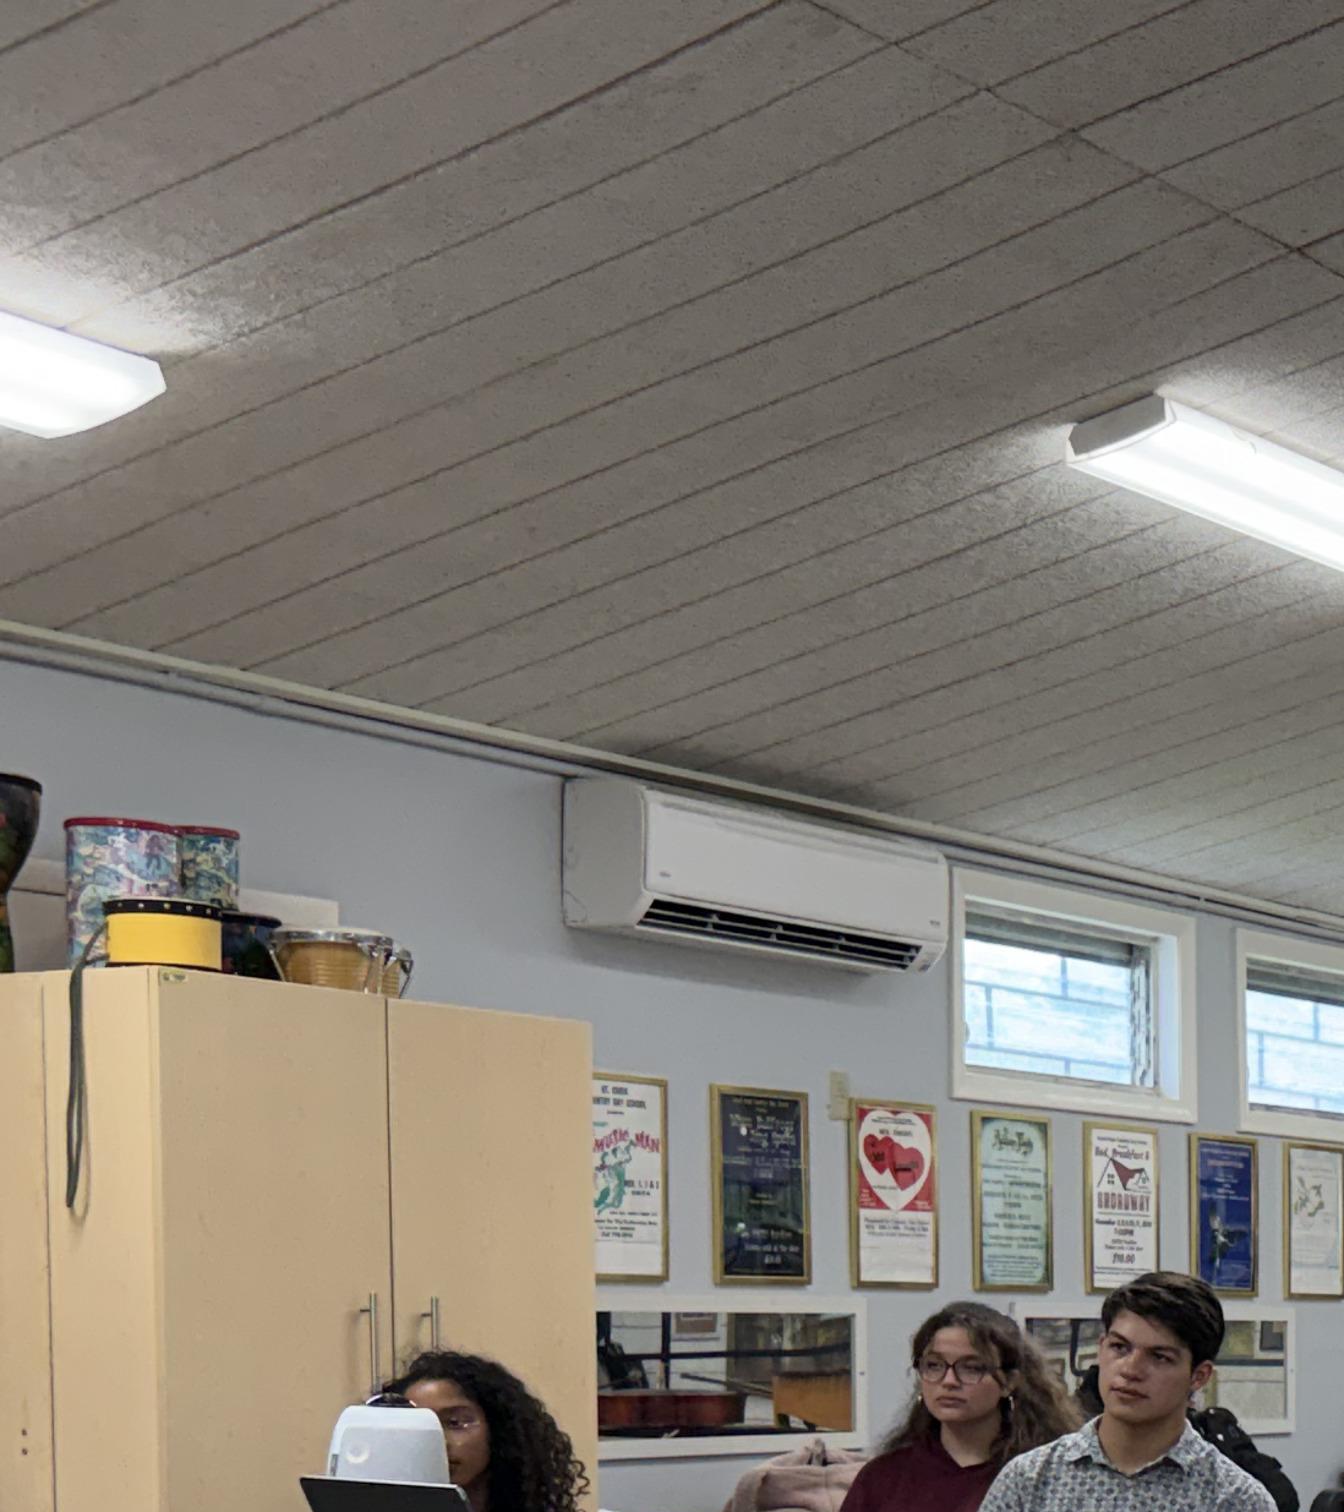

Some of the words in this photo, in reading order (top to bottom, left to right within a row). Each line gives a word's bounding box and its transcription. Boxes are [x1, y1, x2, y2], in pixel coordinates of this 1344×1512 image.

[592, 1129, 629, 1153] MUSIC
[635, 1130, 660, 1154] MAN
[1097, 1191, 1150, 1212] BROADWAY
